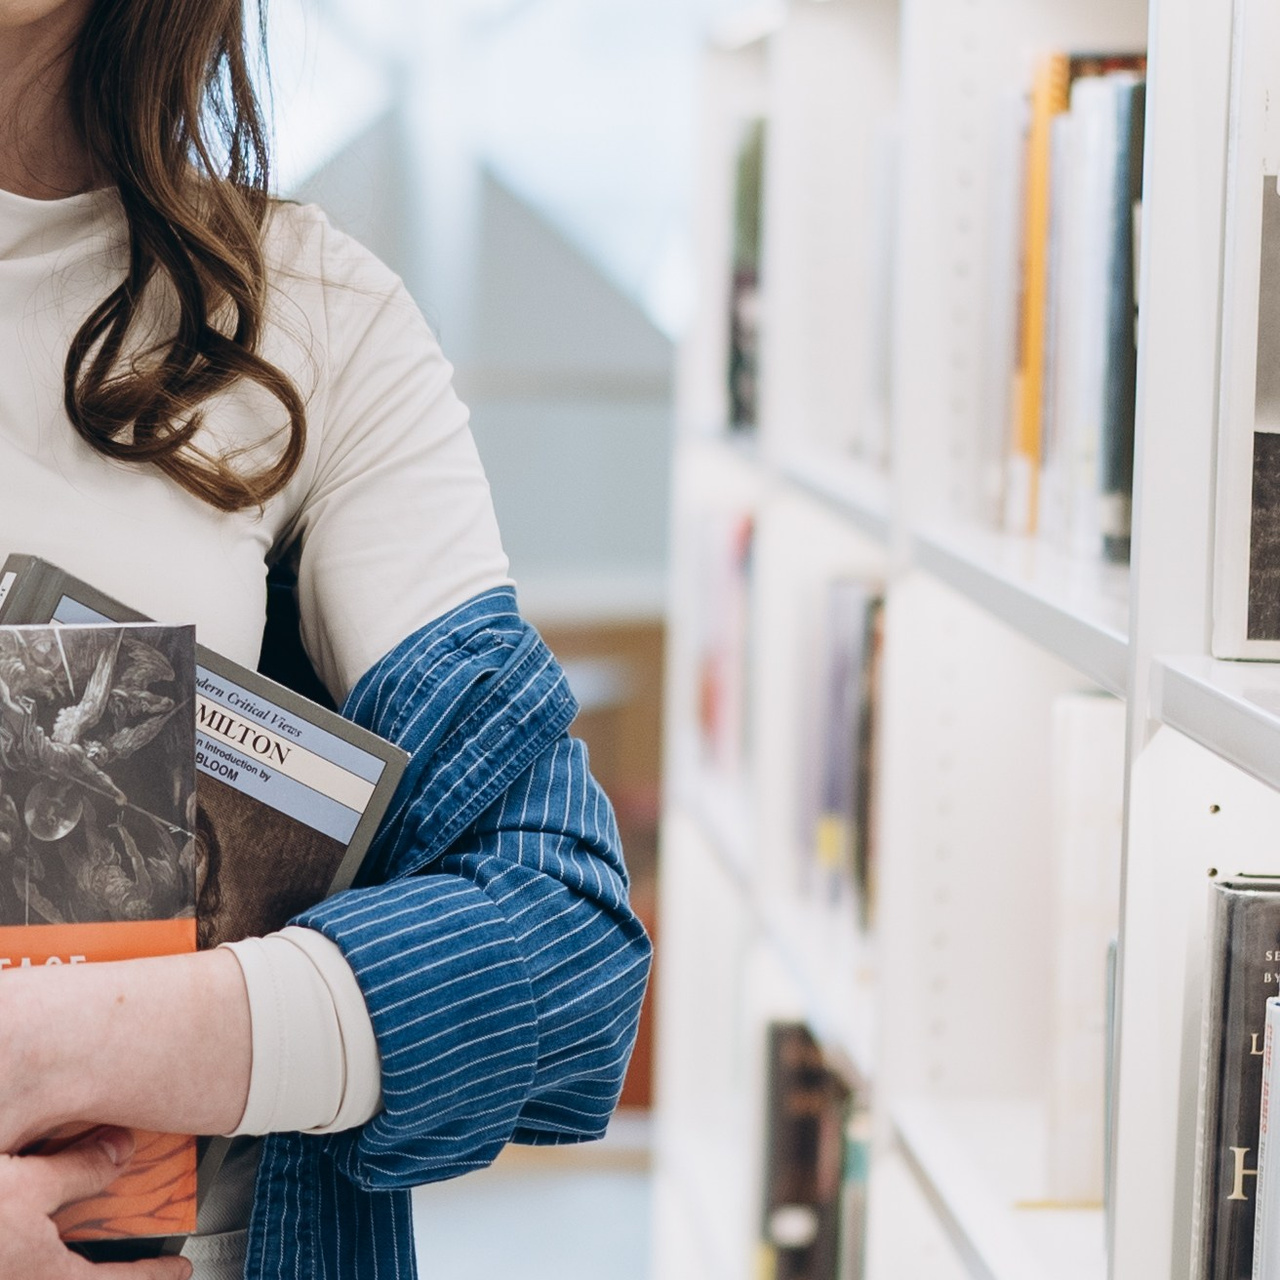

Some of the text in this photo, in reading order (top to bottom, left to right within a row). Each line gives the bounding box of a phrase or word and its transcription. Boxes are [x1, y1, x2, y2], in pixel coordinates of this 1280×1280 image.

[196, 703, 292, 765] MILTON
[227, 692, 271, 720] Critical
[271, 713, 302, 738] Views
[195, 751, 239, 782] BLOOM
[204, 740, 259, 775] Introduction
[259, 769, 272, 783] by
